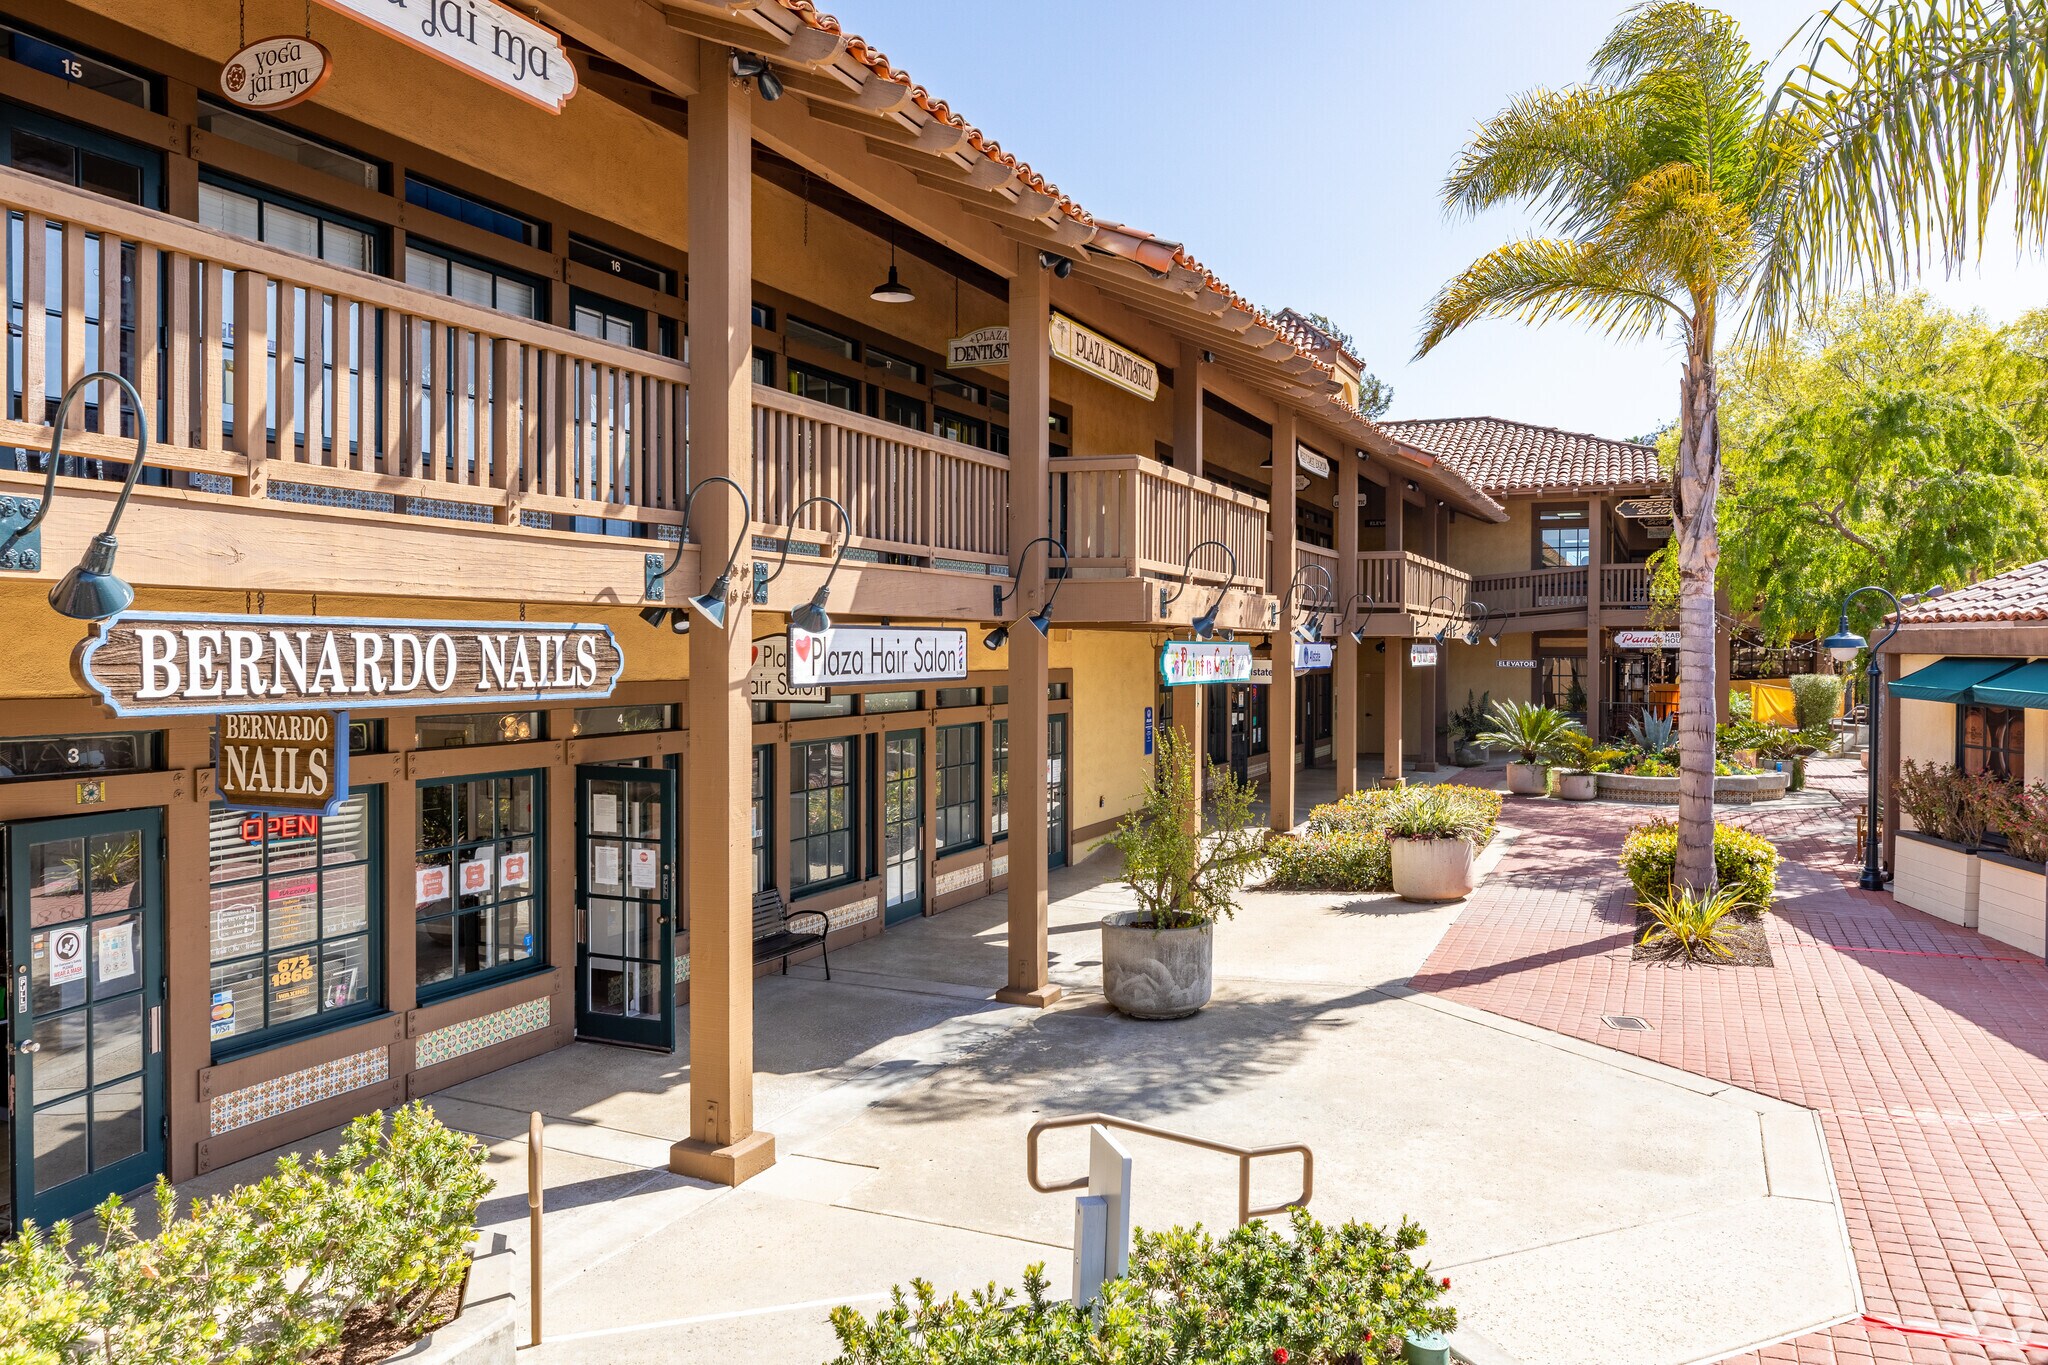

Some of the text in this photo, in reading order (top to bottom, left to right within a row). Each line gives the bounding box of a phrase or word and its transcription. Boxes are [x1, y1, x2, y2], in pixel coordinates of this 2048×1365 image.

[421, 0, 550, 80] jai ma
[61, 58, 82, 79] 15
[255, 42, 301, 75] yoga
[248, 67, 309, 102] jai ma
[611, 260, 620, 272] 16
[975, 329, 1008, 343] PLAZA
[954, 343, 1009, 362] DENTIST
[1075, 331, 1153, 391] PLAZA DENTISTRY
[886, 360, 891, 368] 17
[134, 629, 598, 699] BERNARDO NAILS
[763, 645, 786, 668] Pla
[812, 637, 956, 676] Plaza Hair Salon
[1250, 668, 1272, 676] lstate
[751, 673, 771, 695] air
[225, 714, 328, 742] BERNARDO
[617, 713, 624, 724] 4
[67, 748, 80, 763] 3
[223, 745, 328, 797] NAILS
[242, 814, 317, 840] OPEN
[277, 954, 310, 973] 673
[271, 966, 314, 987] 1866
[278, 988, 308, 1000] WAXING
